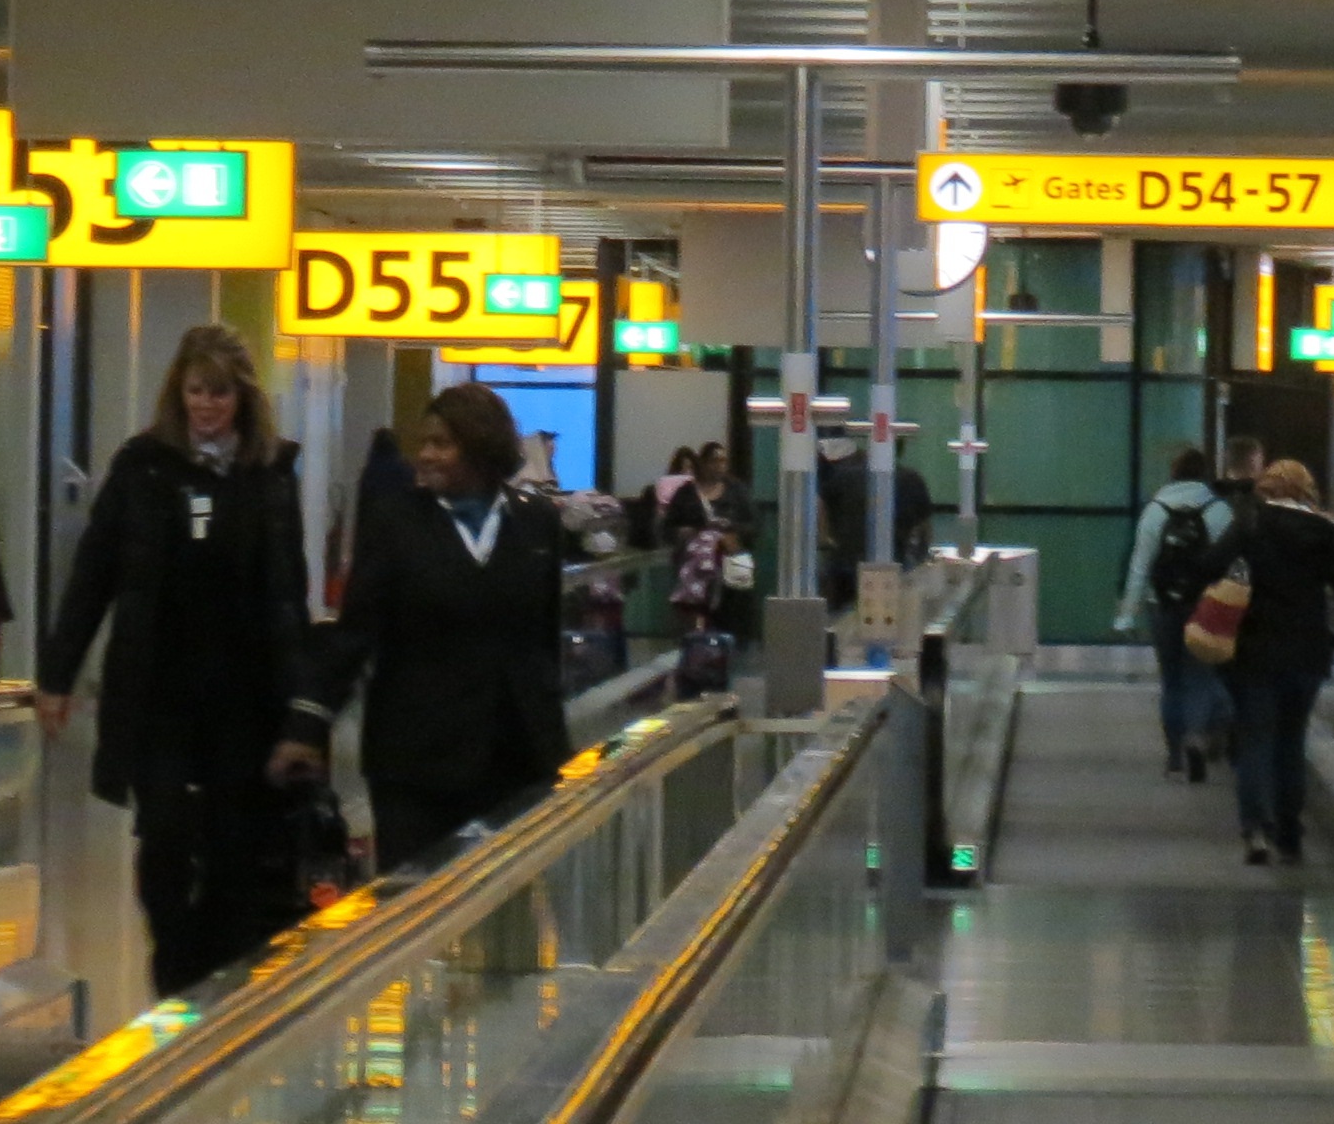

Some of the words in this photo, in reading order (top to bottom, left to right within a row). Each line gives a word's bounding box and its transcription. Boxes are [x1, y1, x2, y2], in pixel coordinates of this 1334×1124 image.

[1044, 175, 1127, 200] Gates
[1138, 170, 1321, 213] D54-57
[298, 249, 471, 322] D55
